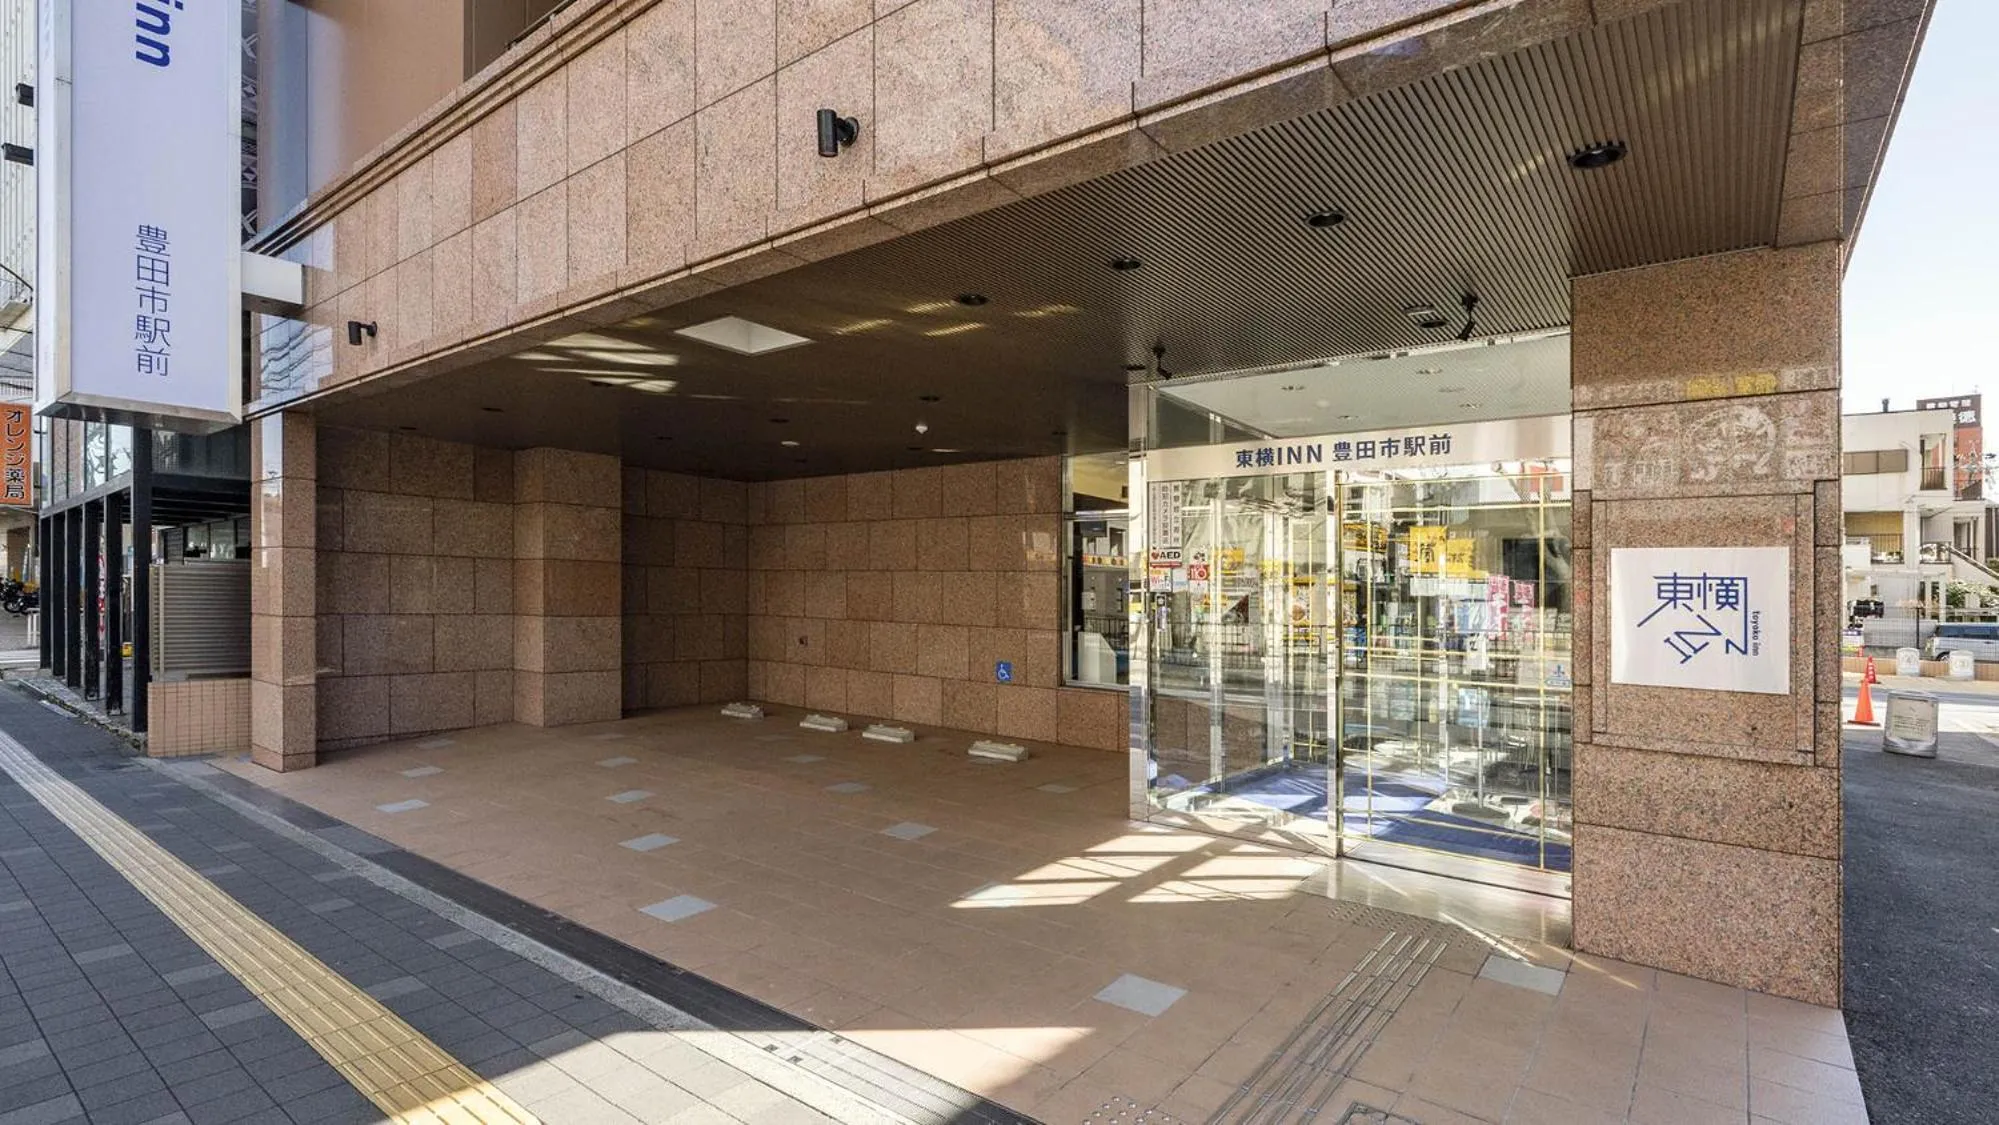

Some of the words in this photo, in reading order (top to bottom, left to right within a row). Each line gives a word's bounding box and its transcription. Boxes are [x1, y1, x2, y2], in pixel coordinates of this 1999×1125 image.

[135, 224, 171, 376] 豊田市駅前
[5, 410, 25, 499] オレンジ薬局
[1235, 444, 1323, 468] 東横INN
[1332, 433, 1453, 462] 豊田市駅前
[1160, 551, 1181, 559] AED
[1750, 610, 1761, 641] toyoko
[1752, 642, 1761, 657] inn
